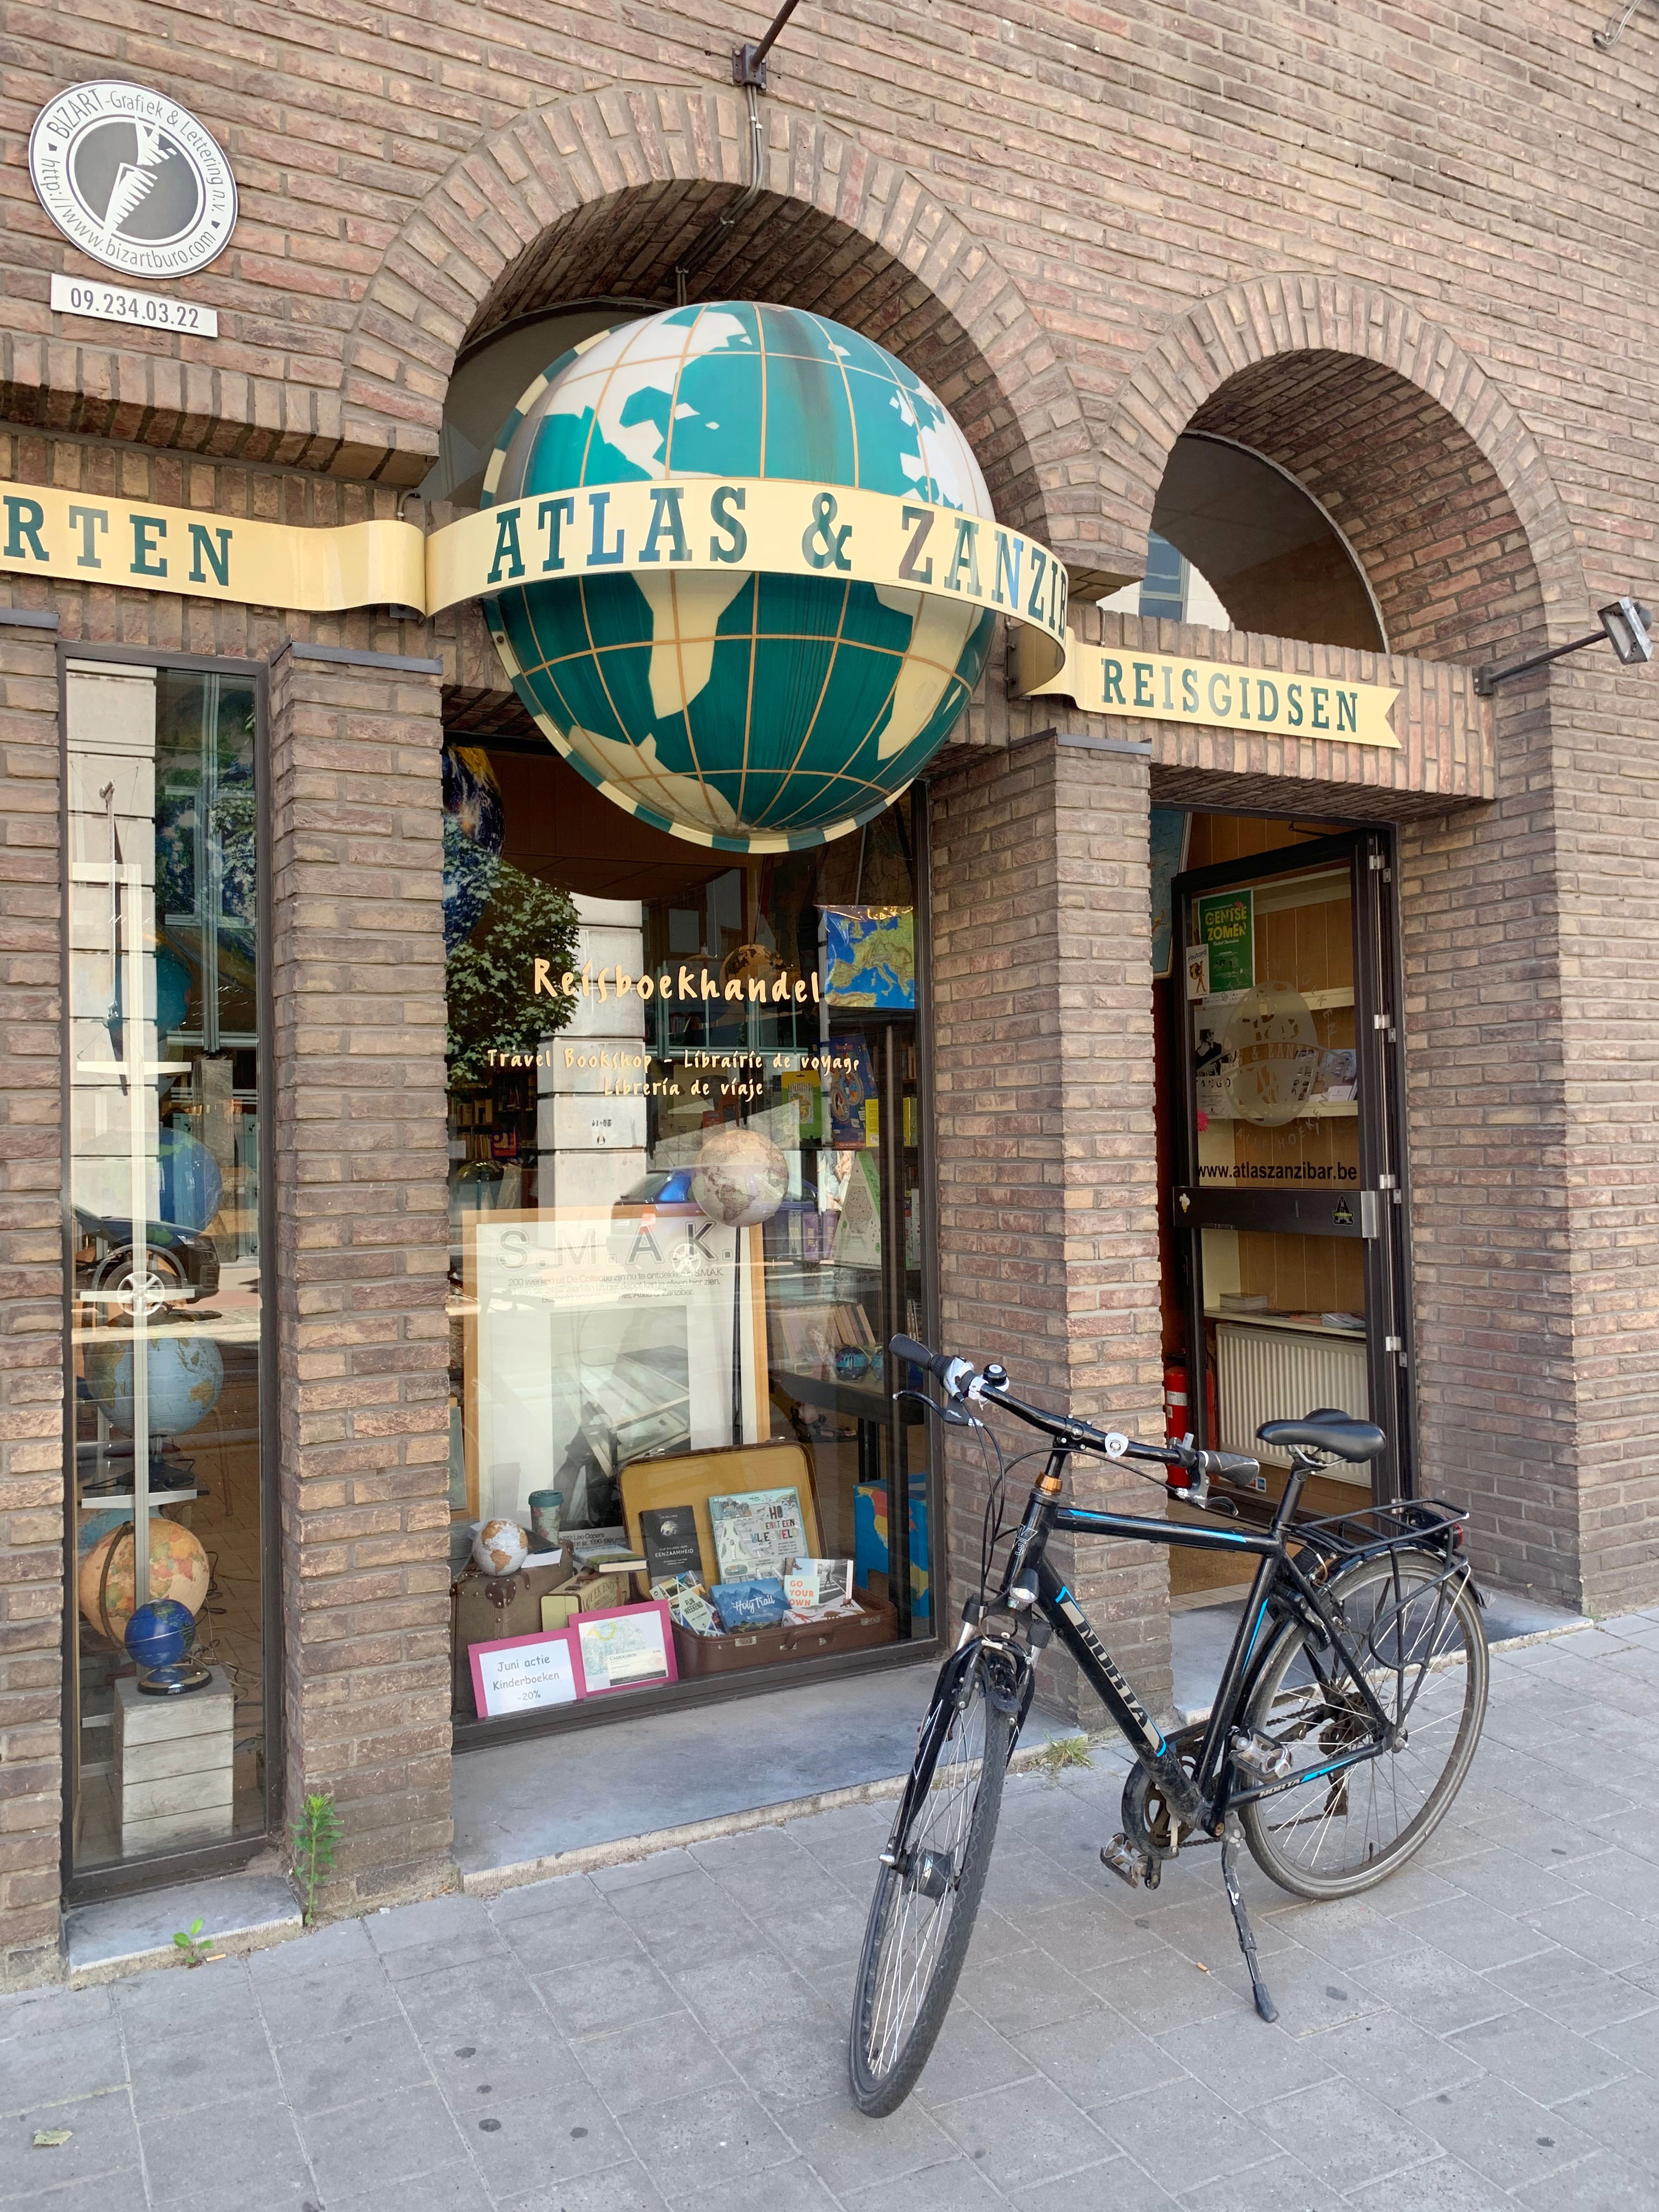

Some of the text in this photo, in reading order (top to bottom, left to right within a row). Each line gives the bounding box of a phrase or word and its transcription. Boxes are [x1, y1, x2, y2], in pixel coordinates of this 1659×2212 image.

[167, 110, 178, 127] &
[180, 121, 223, 185] Lettering
[211, 189, 225, 212] n.v.
[40, 157, 217, 268] http://www.bizartburo.com
[71, 287, 199, 329] 09.234.03.22
[2, 495, 233, 588] RTEN
[486, 486, 748, 584] ATLAS
[801, 492, 852, 571] &
[1101, 658, 1358, 732] REISGIDSEN
[1205, 905, 1247, 926] GENTSE
[1207, 922, 1247, 941] ZOMER
[1188, 948, 1207, 962] routard
[534, 958, 820, 1003] Reisboekhandel
[487, 1049, 551, 1067] Travel
[564, 1048, 652, 1073] Bookshop
[684, 1049, 763, 1068] Librairie
[773, 1053, 791, 1068] de
[691, 1079, 710, 1096] de
[720, 1078, 763, 1102] viaje
[1198, 1161, 1357, 1181] www.atlaszanzibar.be
[496, 1221, 733, 1272] S.M.A.K.
[508, 1278, 523, 1286] 200
[525, 1276, 554, 1285] werken
[556, 1276, 565, 1284] uit
[614, 1273, 626, 1282] zijn
[647, 1271, 688, 1279] ontdekken
[666, 1279, 688, 1287] alleen
[769, 1505, 789, 1520] HOE
[782, 1519, 795, 1528] EEN
[654, 1548, 694, 1558] EENZAAMHEID
[684, 1601, 704, 1615] WEEKEND
[732, 1594, 776, 1615] Holy Trail
[496, 1655, 551, 1672] Juni actie
[493, 1672, 560, 1691] Kinderboeken
[1075, 1620, 1149, 1729] NORTA
[517, 1690, 541, 1701] -20%
[1259, 1779, 1300, 1798] NORTA
